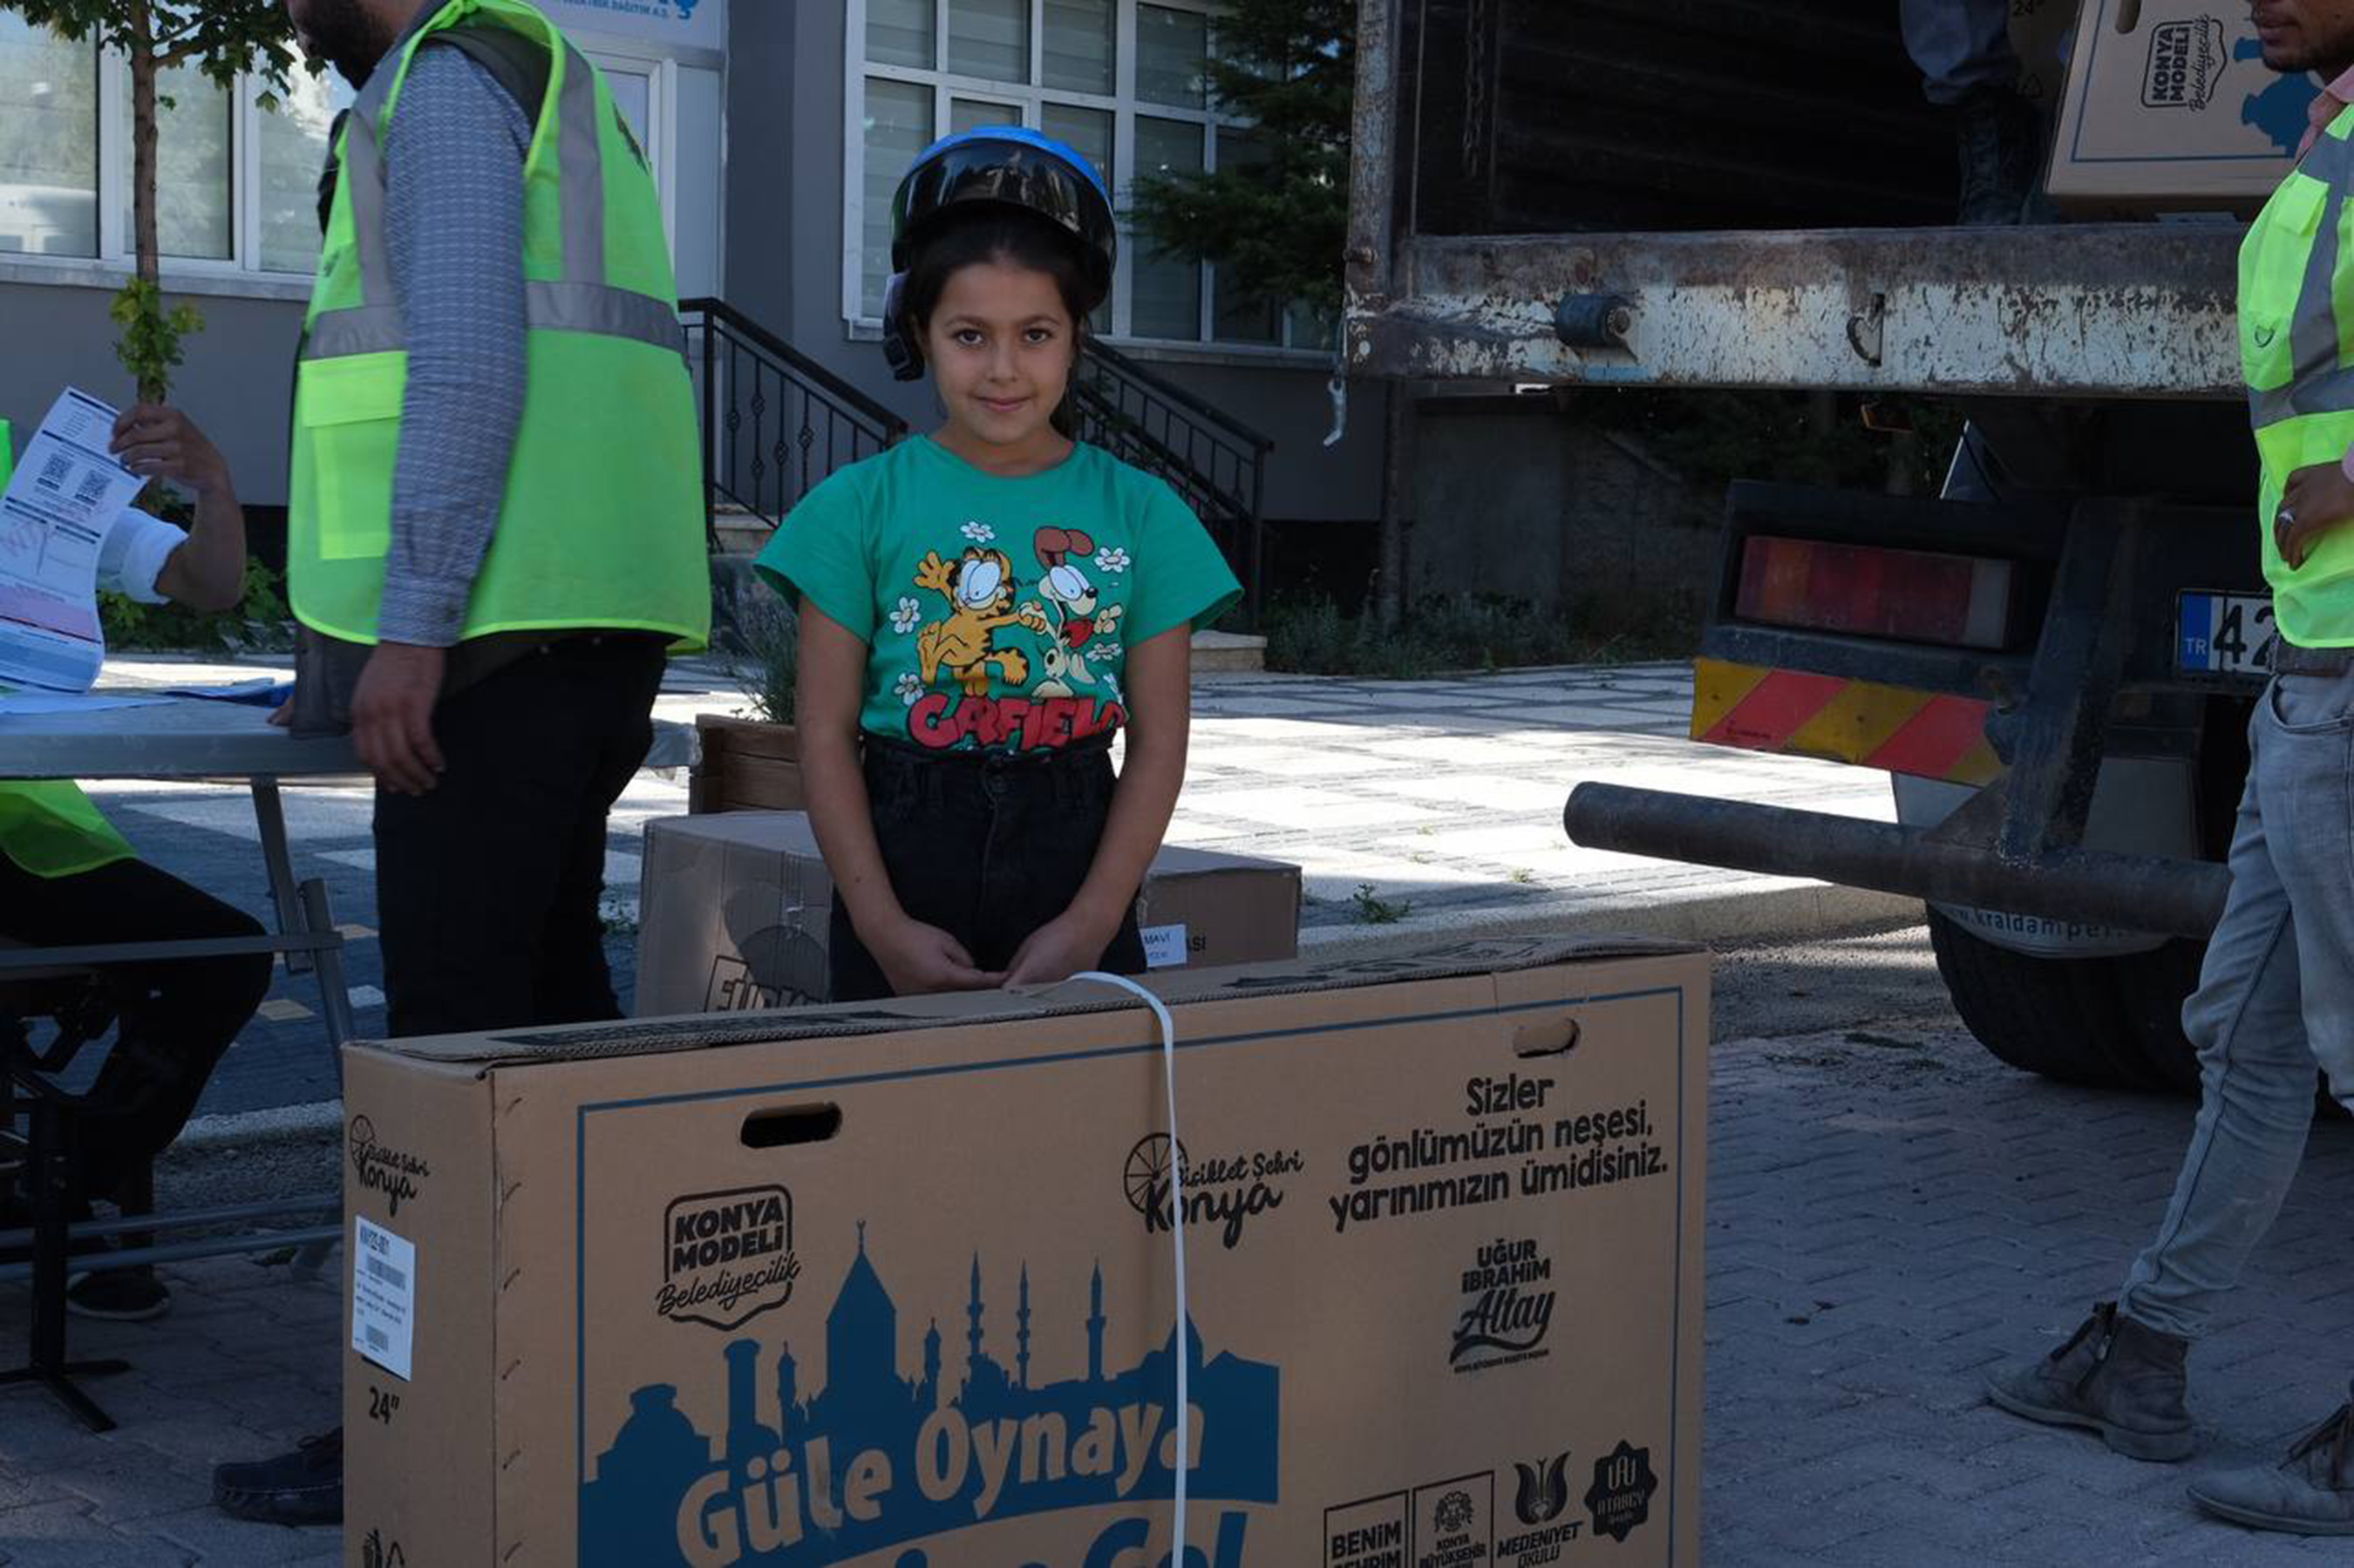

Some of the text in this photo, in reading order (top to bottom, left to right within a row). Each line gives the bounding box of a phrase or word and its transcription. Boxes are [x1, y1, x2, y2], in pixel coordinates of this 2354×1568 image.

[2151, 28, 2174, 101] KONYA
[2169, 27, 2190, 102] MODELİ
[2184, 638, 2208, 655] TR
[1466, 1073, 1554, 1117] Sizler
[1348, 1100, 1653, 1184] gönlümüzün neşesi,
[358, 1148, 418, 1217] Konya
[1144, 1178, 1283, 1248] Konya
[1330, 1144, 1669, 1232] yarınımızın ümidisiniz.
[672, 1225, 784, 1273] MODELİ
[673, 1195, 785, 1244] KONYA
[656, 1250, 801, 1316] Belediyecilik
[1461, 1259, 1551, 1294] İBRAHİM
[1477, 1239, 1537, 1267] UĞUR
[1451, 1288, 1556, 1355] Altay
[675, 1402, 1205, 1568] Güle Oynaya
[1330, 1519, 1402, 1559] BENİM
